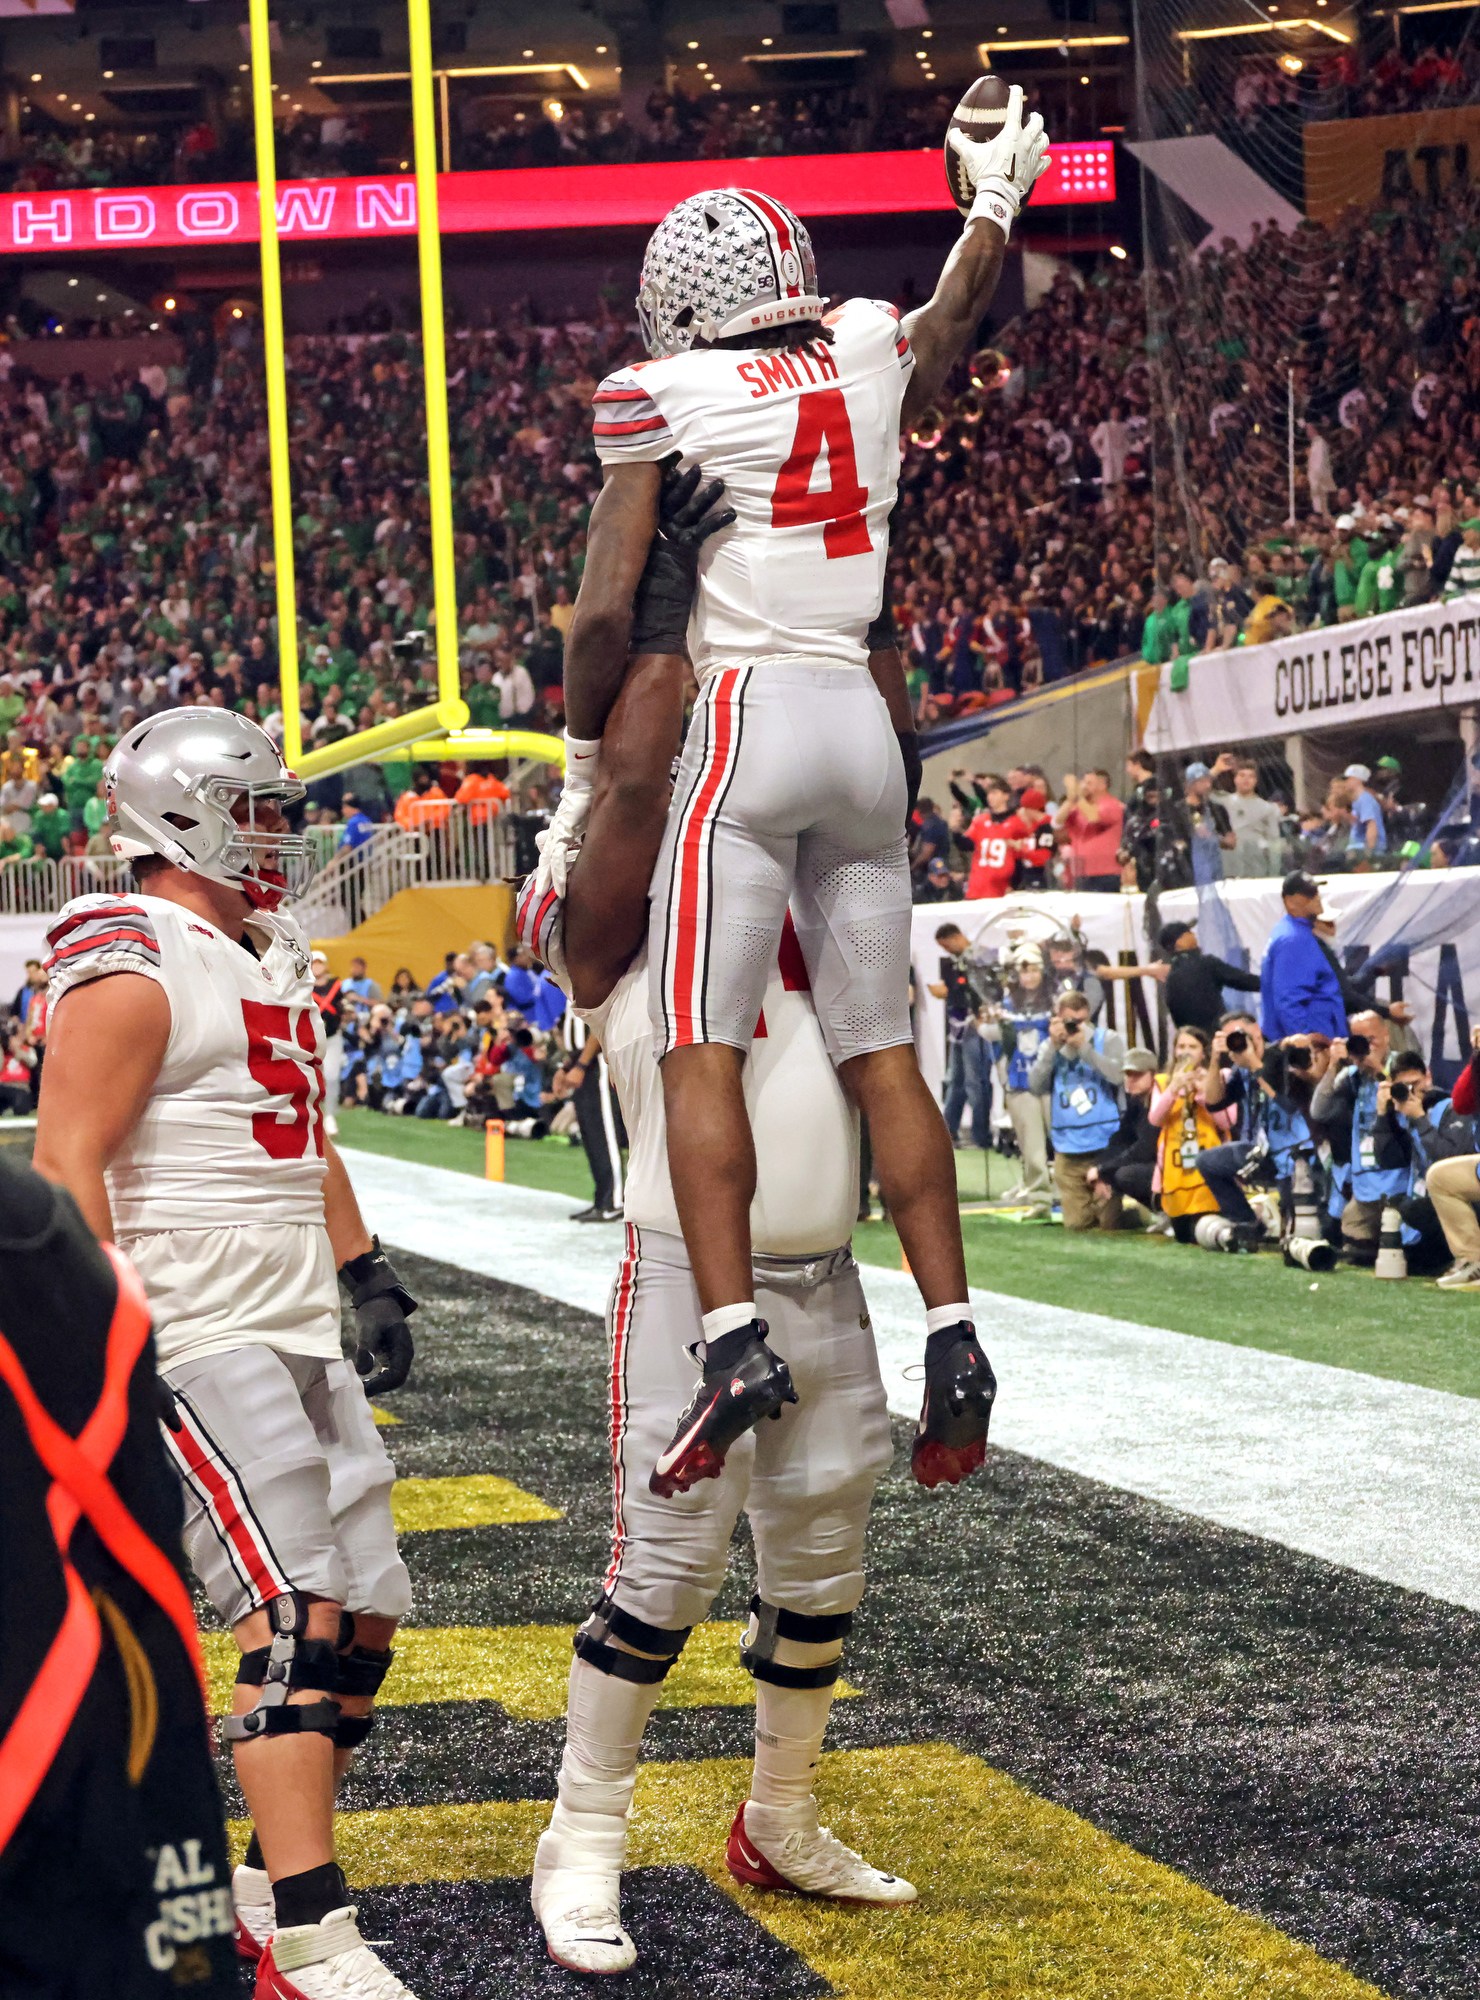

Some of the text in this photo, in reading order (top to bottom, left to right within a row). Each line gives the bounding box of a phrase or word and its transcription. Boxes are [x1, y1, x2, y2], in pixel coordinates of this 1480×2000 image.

[737, 342, 840, 398] SMITH
[770, 388, 875, 560] 4
[1275, 618, 1480, 717] COLLEGE FOOT
[978, 838, 1007, 868] 19
